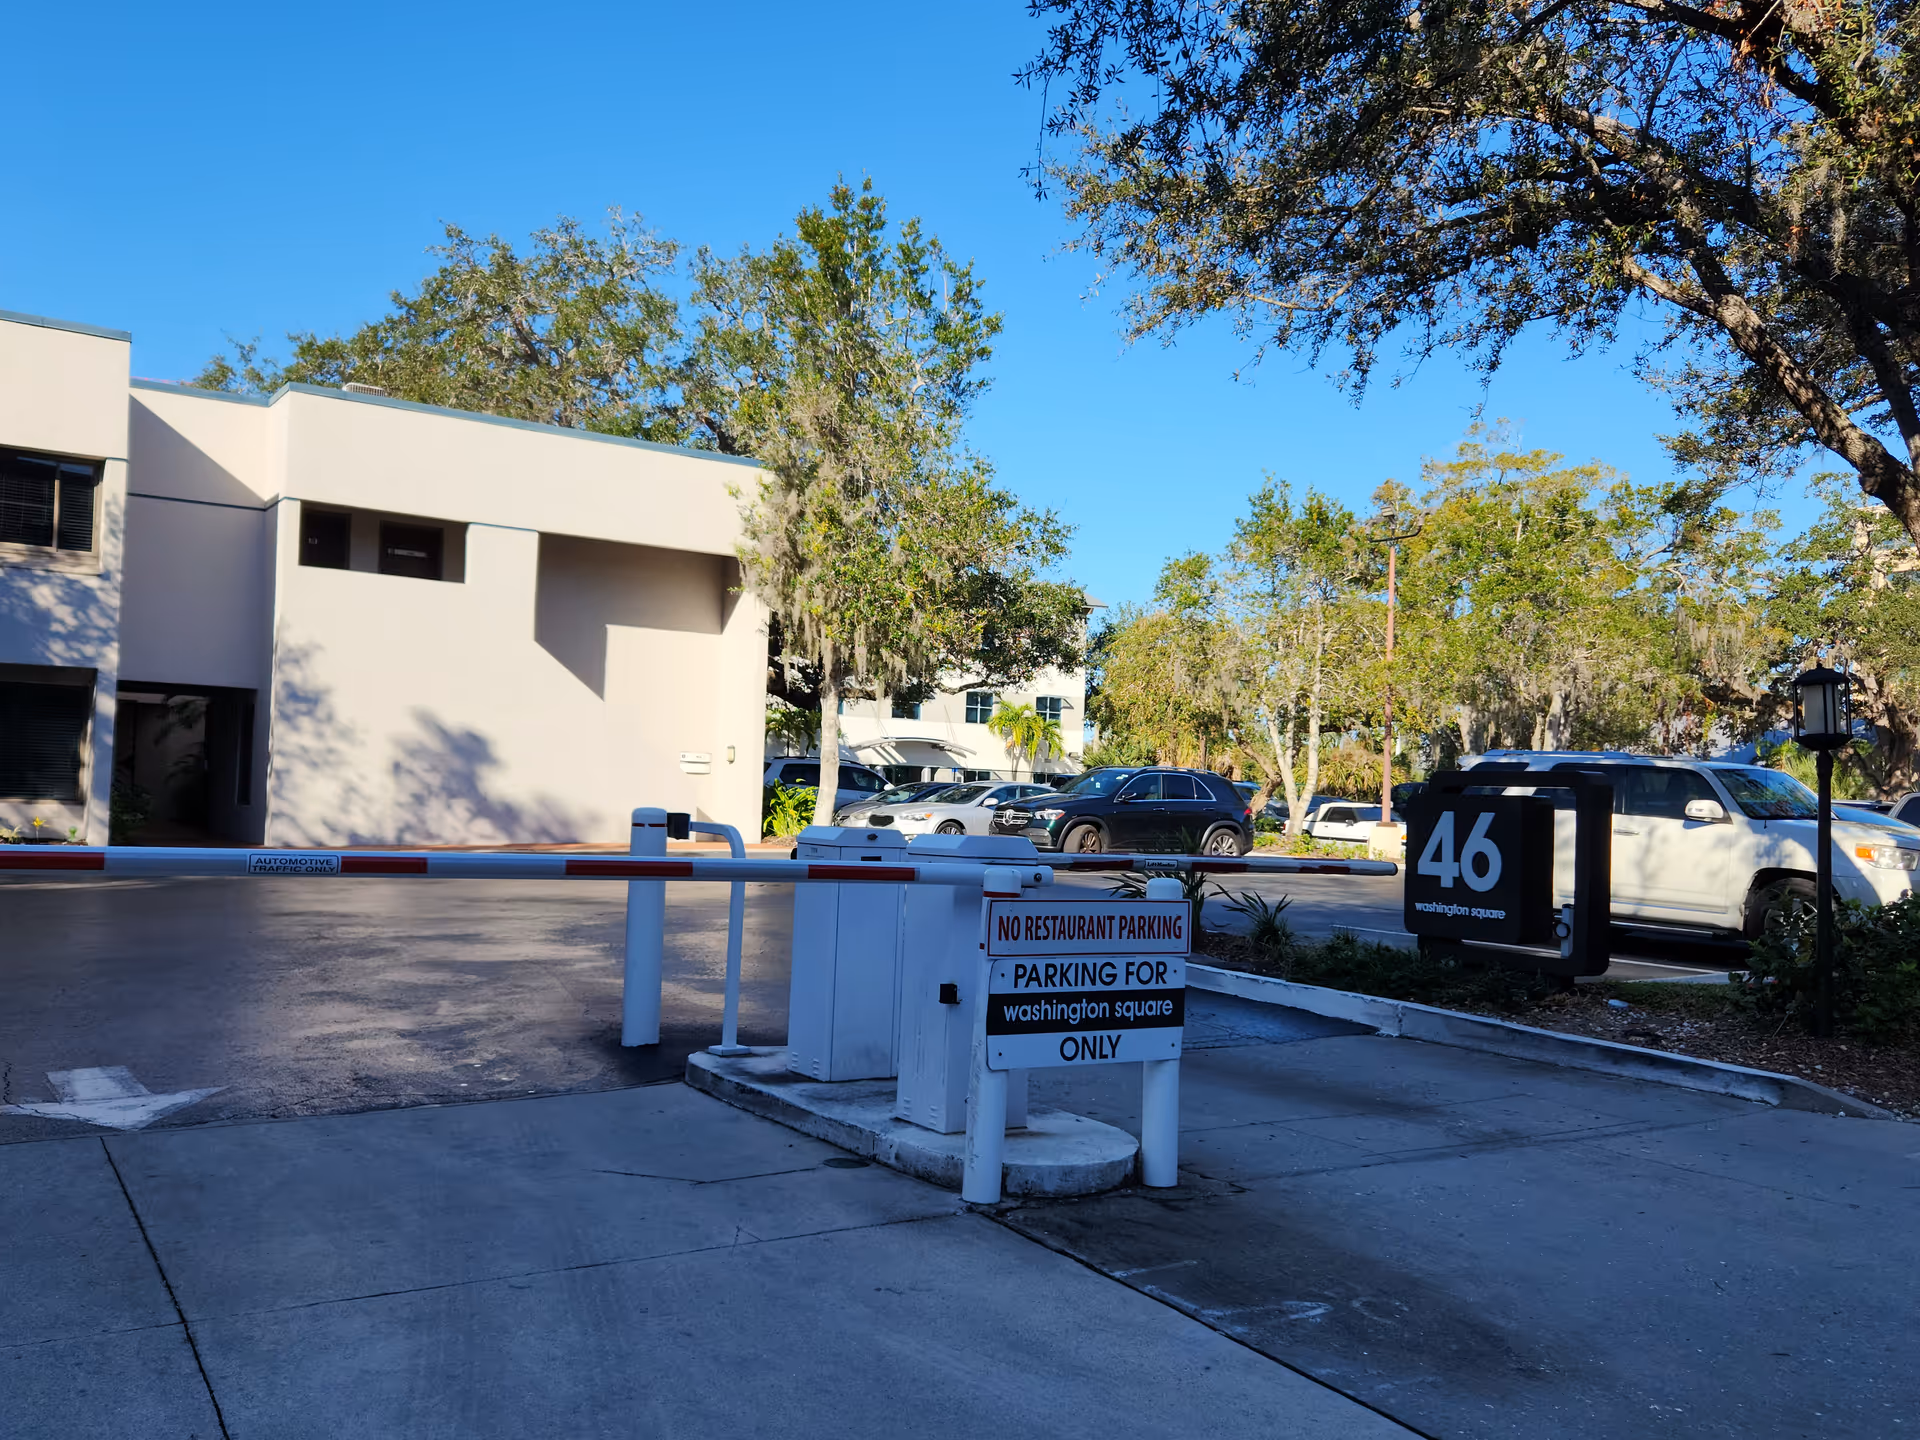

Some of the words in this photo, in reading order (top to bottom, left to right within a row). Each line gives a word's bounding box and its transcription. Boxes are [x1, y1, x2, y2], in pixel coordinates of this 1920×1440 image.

[255, 857, 333, 866] AUTOMOTIVE
[1417, 810, 1502, 892] 46
[252, 865, 301, 873] TRAFFIC
[305, 865, 336, 873] ONLY
[1414, 901, 1469, 917] washington
[1470, 907, 1506, 920] square
[997, 915, 1021, 941] NO
[1025, 915, 1115, 941] RESTAURANT
[1118, 914, 1182, 940] PARKING
[1013, 961, 1117, 989] PARKING
[1125, 961, 1168, 985] FOR
[1003, 998, 1110, 1025] washington
[1114, 998, 1173, 1021] square
[1059, 1034, 1122, 1062] ONLY
